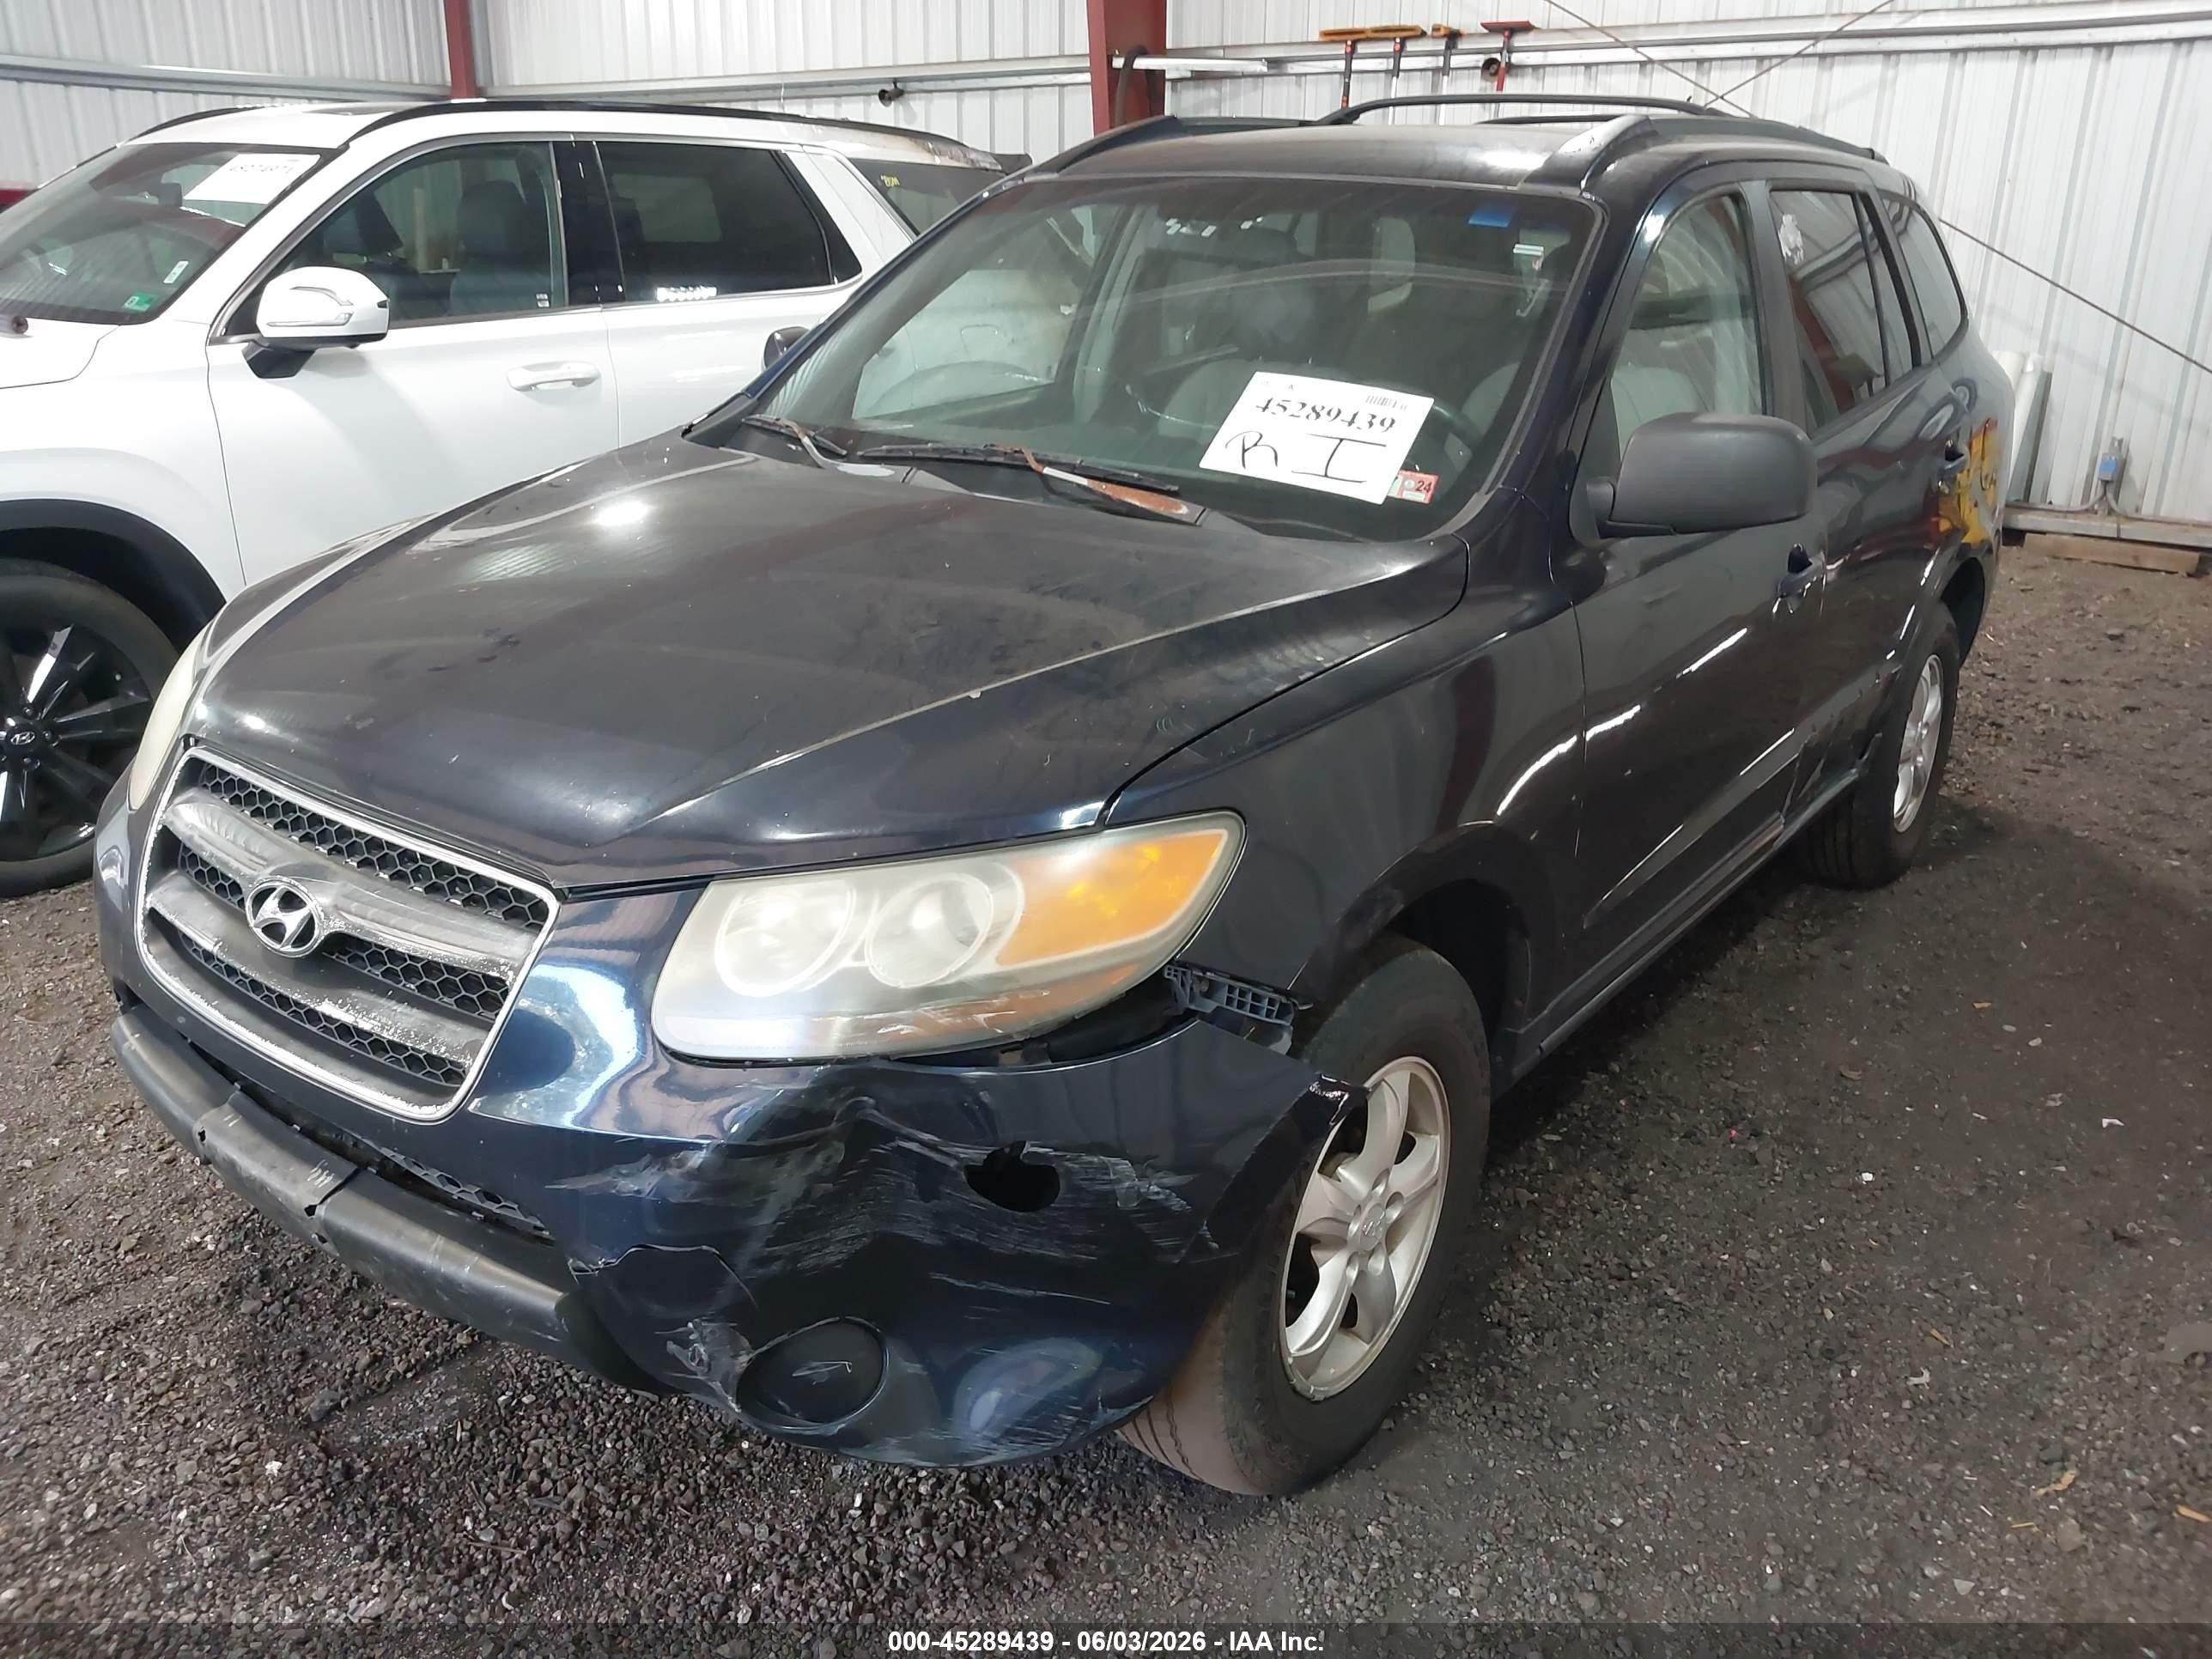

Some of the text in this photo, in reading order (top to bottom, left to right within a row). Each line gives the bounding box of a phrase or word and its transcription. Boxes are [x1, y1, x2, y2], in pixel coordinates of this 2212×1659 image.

[1255, 397, 1396, 433] 45289439
[1224, 429, 1279, 469] R
[1414, 480, 1432, 493] 24
